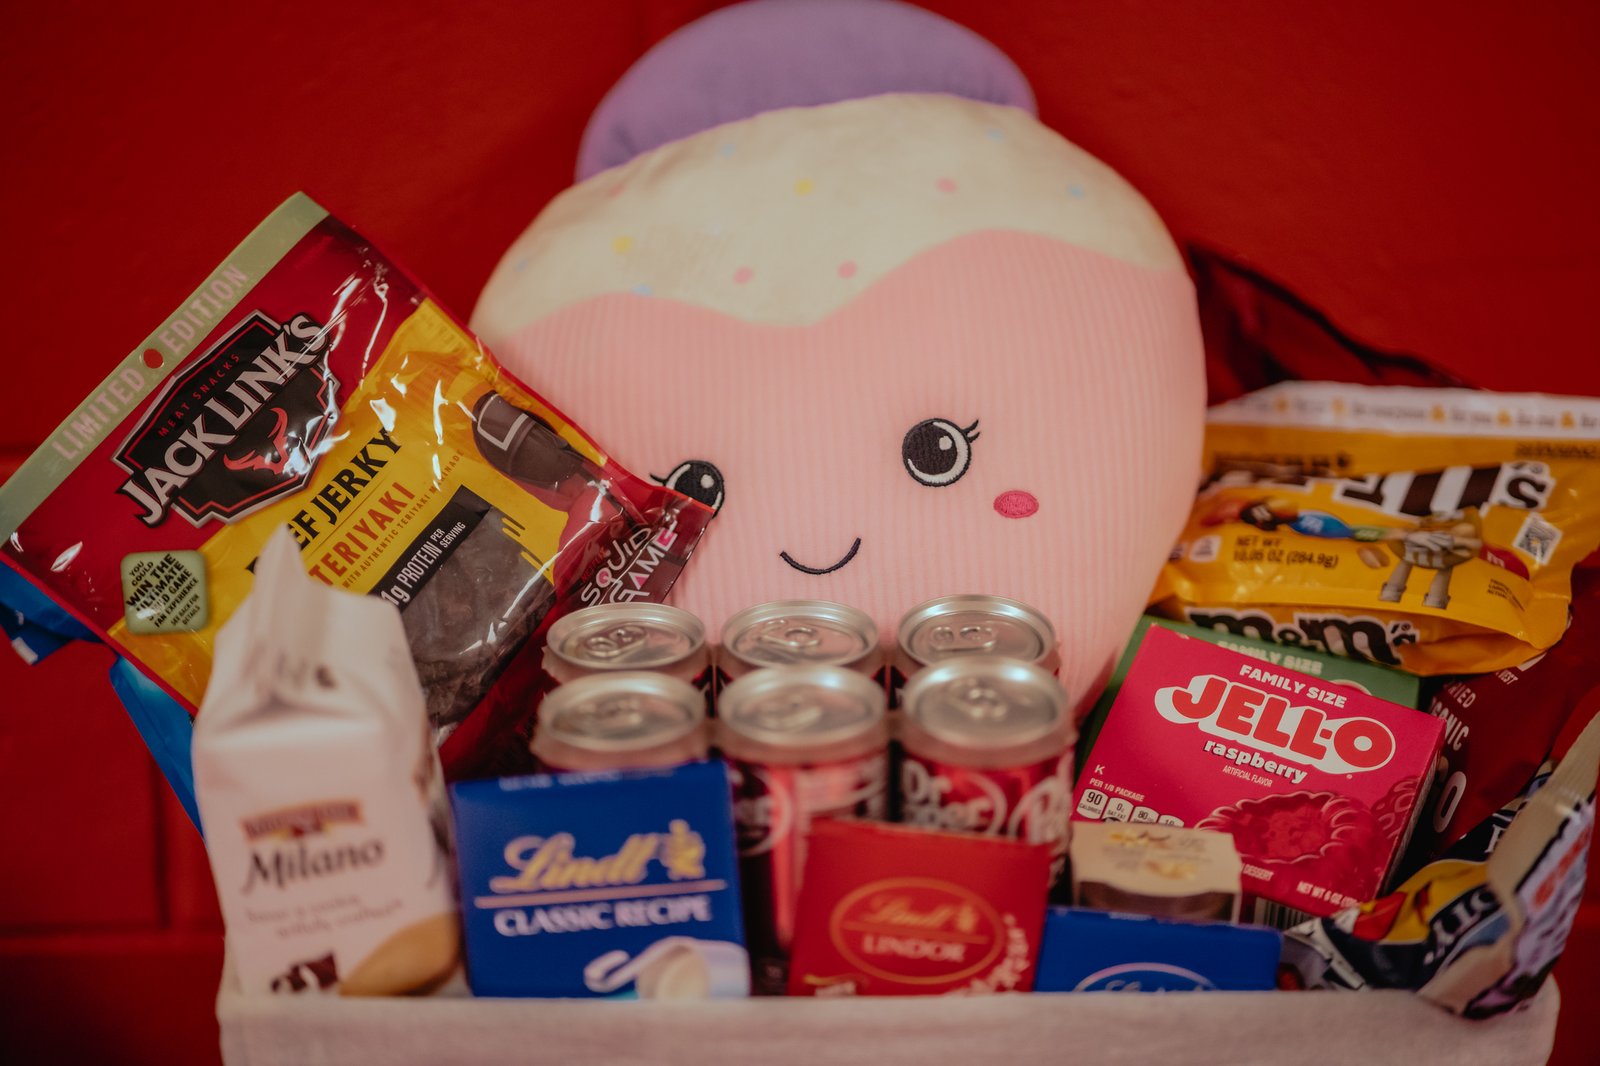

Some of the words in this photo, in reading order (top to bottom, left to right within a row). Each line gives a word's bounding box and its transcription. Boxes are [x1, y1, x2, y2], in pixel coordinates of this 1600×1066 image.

[51, 366, 146, 460] LIMITED
[158, 263, 250, 355] EDITION
[121, 414, 237, 525] JACK
[203, 314, 327, 430] LINK'S
[158, 402, 191, 437] MEAT
[192, 353, 240, 399] SNACKS
[310, 426, 402, 526] JERKY
[308, 481, 416, 586] TERIYAKI
[341, 570, 362, 588] WITH
[361, 529, 399, 572] AUTHENTIC
[396, 541, 443, 589] PROTEIN
[430, 528, 446, 542] PER
[439, 521, 466, 549] SERVING
[126, 579, 153, 607] WIN
[150, 553, 176, 579] THE
[129, 560, 145, 577] YOU
[131, 561, 154, 587] COULD
[168, 568, 192, 594] GAME
[581, 527, 652, 607] SQUID
[609, 520, 678, 604] GAME
[154, 614, 166, 628] FAN
[165, 577, 199, 614] EXPERIENCE
[1239, 664, 1306, 694] FAMILY
[1306, 686, 1348, 708] SIZE
[1156, 675, 1396, 774] JELL-O
[1203, 739, 1308, 784] raspberry
[1222, 765, 1252, 782] ARTIFICIAL
[1252, 773, 1273, 787] FLAVOR
[1086, 791, 1103, 806] 90
[1089, 777, 1103, 788] PER
[1114, 786, 1145, 802] PACKAGE
[239, 838, 386, 895] Milano
[489, 831, 660, 893] Lindt
[494, 904, 612, 937] CLASSIC
[613, 894, 712, 928] RECIPE
